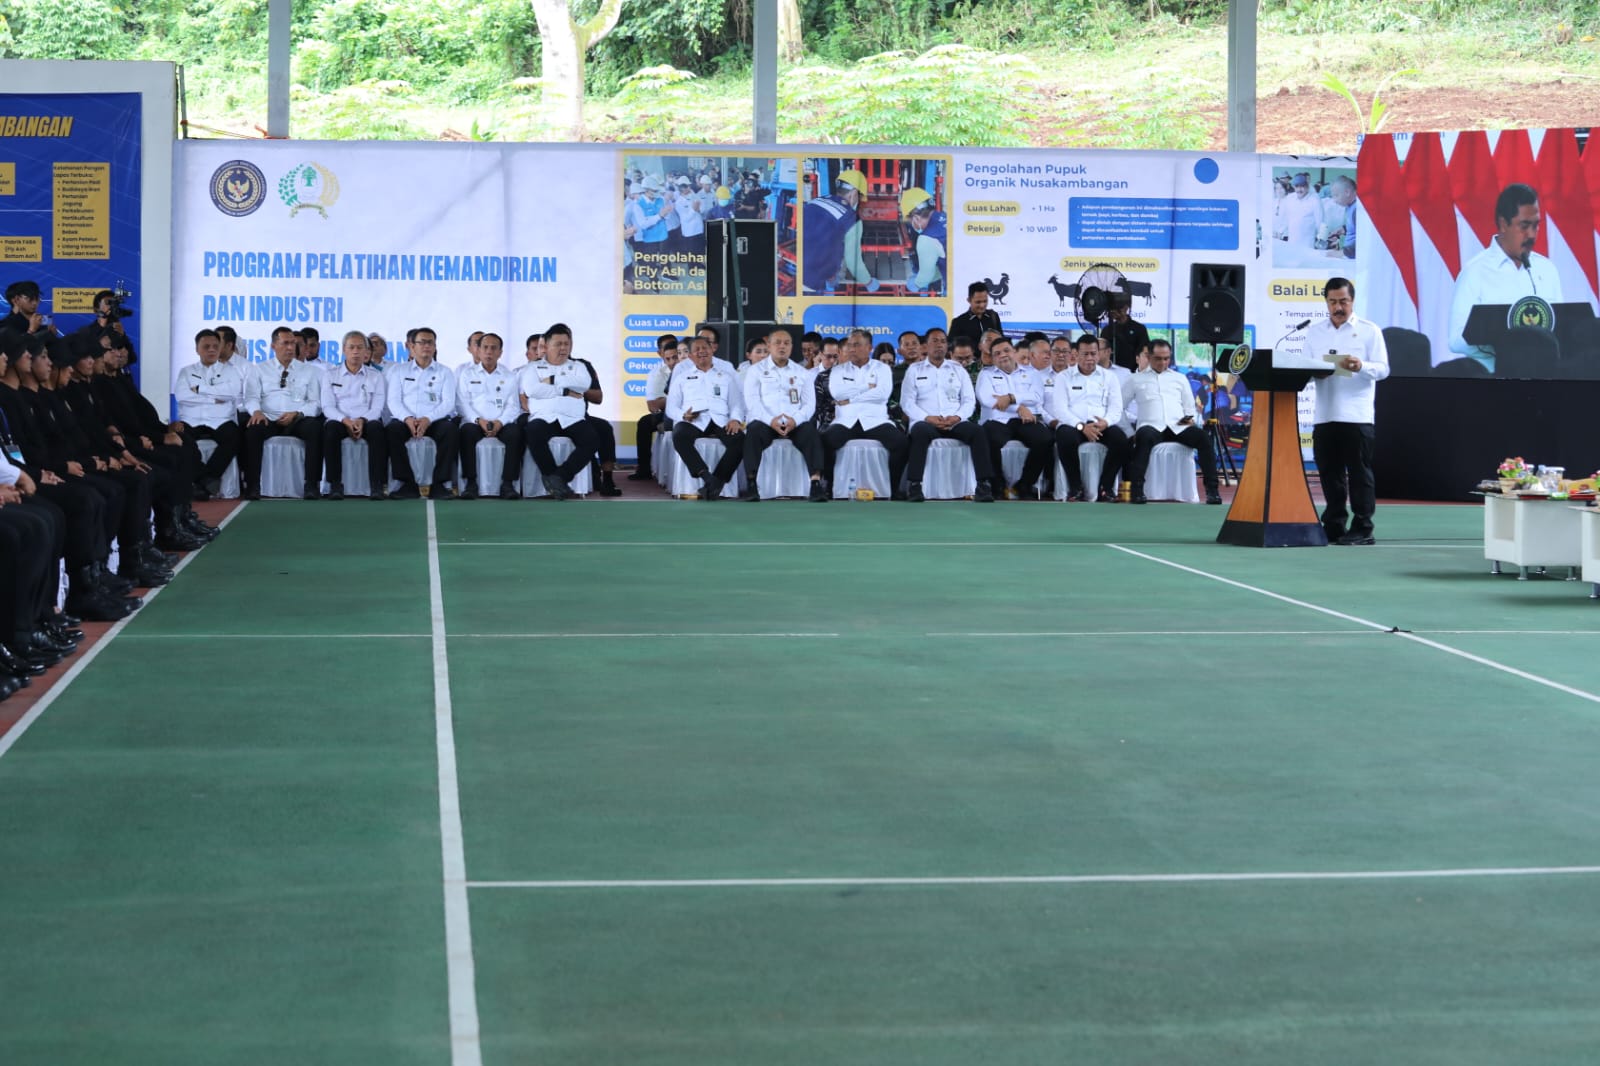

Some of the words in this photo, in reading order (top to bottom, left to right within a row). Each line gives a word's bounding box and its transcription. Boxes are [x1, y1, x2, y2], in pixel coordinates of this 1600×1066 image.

[965, 163, 1041, 175] Pengolahan
[1045, 164, 1087, 176] Pupuk
[965, 177, 1016, 189] Organik
[1020, 178, 1128, 190] Nusakambangan
[967, 204, 988, 212] Luas
[967, 224, 1001, 234] Pekerja
[203, 251, 302, 279] PROGRAM
[306, 253, 416, 280] PELATIHAN
[419, 255, 557, 282] KEMANDIRIAN
[1063, 260, 1087, 268] Jenis
[1125, 261, 1156, 269] Hewan
[634, 265, 658, 278] (Fly
[661, 266, 686, 277] Ash
[689, 266, 706, 277] da
[634, 280, 684, 290] Bottom
[687, 280, 706, 290] As
[1272, 284, 1308, 296] Balai
[1312, 285, 1326, 296] La
[203, 295, 245, 321] DAN
[249, 295, 344, 322] INDUSTRI
[1285, 310, 1313, 318] Tempat
[628, 319, 652, 327] Luas
[654, 319, 685, 327] Lahan
[628, 339, 652, 348] Luas
[628, 361, 660, 369] Peker
